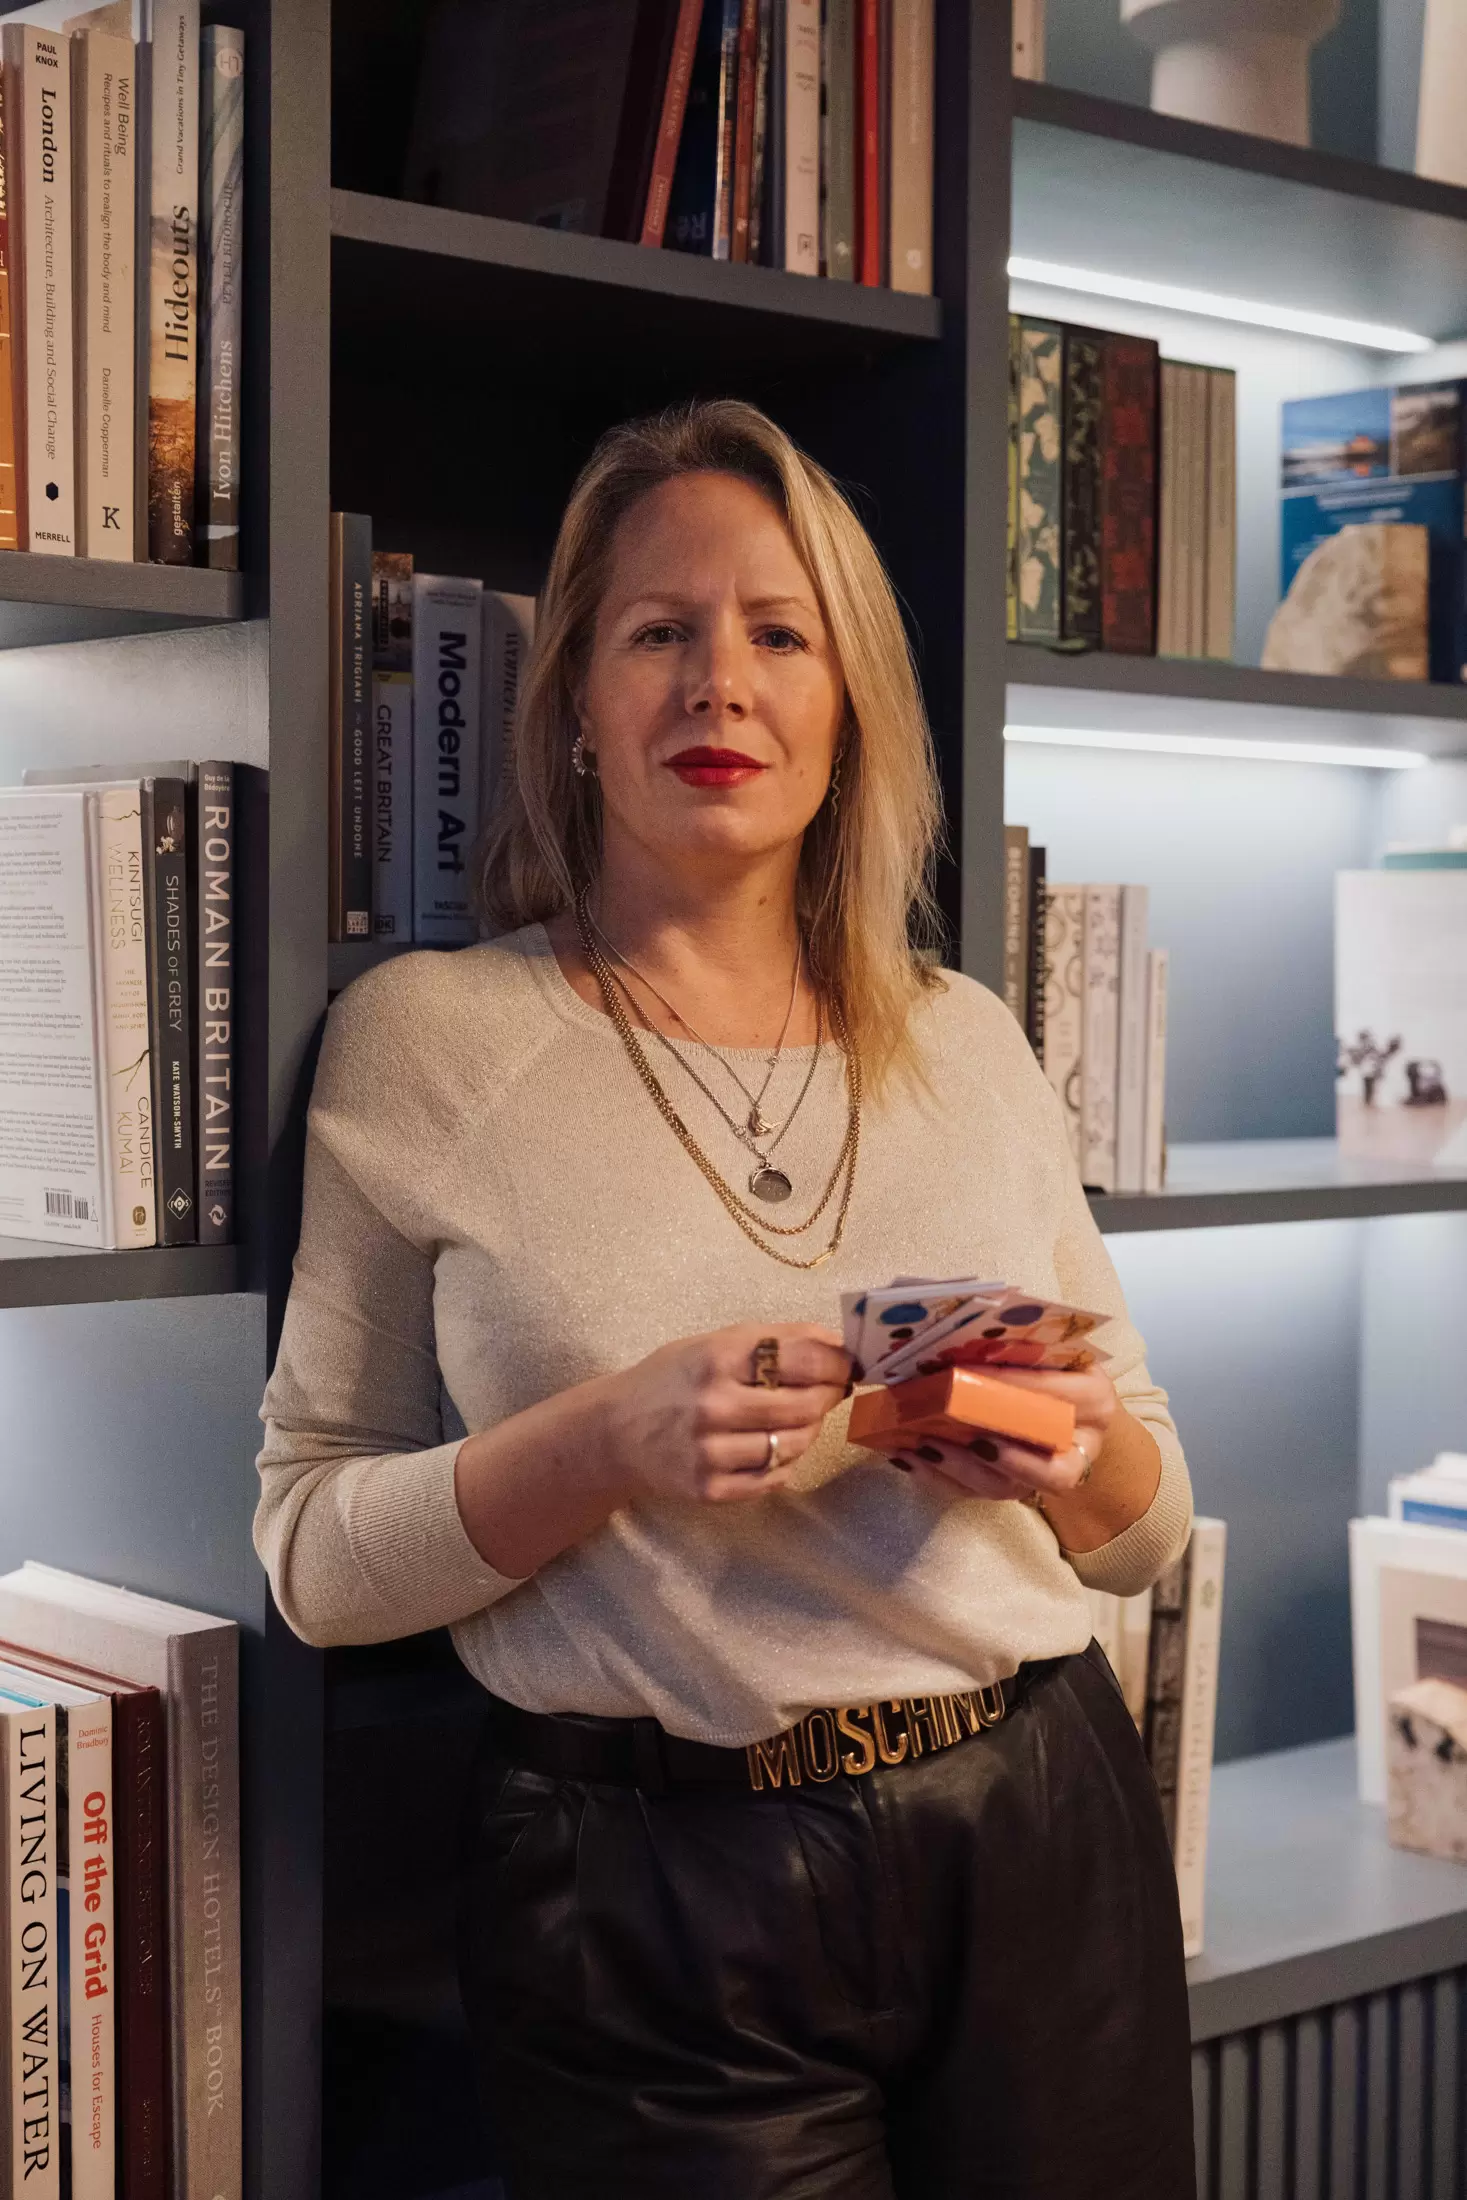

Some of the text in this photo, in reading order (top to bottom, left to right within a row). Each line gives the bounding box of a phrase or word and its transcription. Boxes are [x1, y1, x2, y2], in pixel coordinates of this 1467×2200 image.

[35, 55, 58, 68] KNOX
[36, 42, 57, 55] PAUL
[177, 15, 187, 61] Getaways
[177, 64, 187, 84] Tiny
[113, 77, 130, 156] Well Being
[176, 97, 184, 145] Vacations
[176, 146, 184, 175] Grand
[100, 72, 113, 334] Recipes and rituals to realign the body and mind
[41, 87, 58, 460] London Architecture, Building and Social Change
[163, 205, 190, 362] Hideouts
[100, 367, 112, 478] Danielle Copperman
[213, 340, 233, 442] Hitchens
[102, 506, 121, 530] K
[170, 481, 183, 536] gestalten
[213, 451, 232, 500] Ivon
[35, 531, 71, 543] MERRELL
[353, 581, 364, 858] ADRIANA TRIGIANI GOOD LEFT UNDONE
[438, 631, 467, 797] Modern
[376, 704, 393, 863] GREAT BRITAIN
[437, 808, 466, 874] Art
[108, 841, 126, 950] WELLNESS
[128, 851, 143, 942] KINTSUGI
[165, 875, 183, 1032] SHADES OF GREY
[204, 805, 231, 1171] ROMAN BRITAIN
[116, 1111, 135, 1174] KUMAI
[137, 1096, 152, 1189] CANDICE
[172, 1060, 182, 1149] KATE WATSON-SMYTH
[78, 1725, 109, 1738] Dominic
[201, 1655, 219, 1728] THE
[746, 1681, 1007, 1792] MOSCHINO
[76, 1737, 110, 1750] Bradbury
[201, 1736, 220, 1861] DESIGN
[19, 1723, 50, 2181] LIVING ON WATER
[83, 1791, 109, 2150] Off the Grid Houses for Escape
[206, 2023, 225, 2119] BOOK
